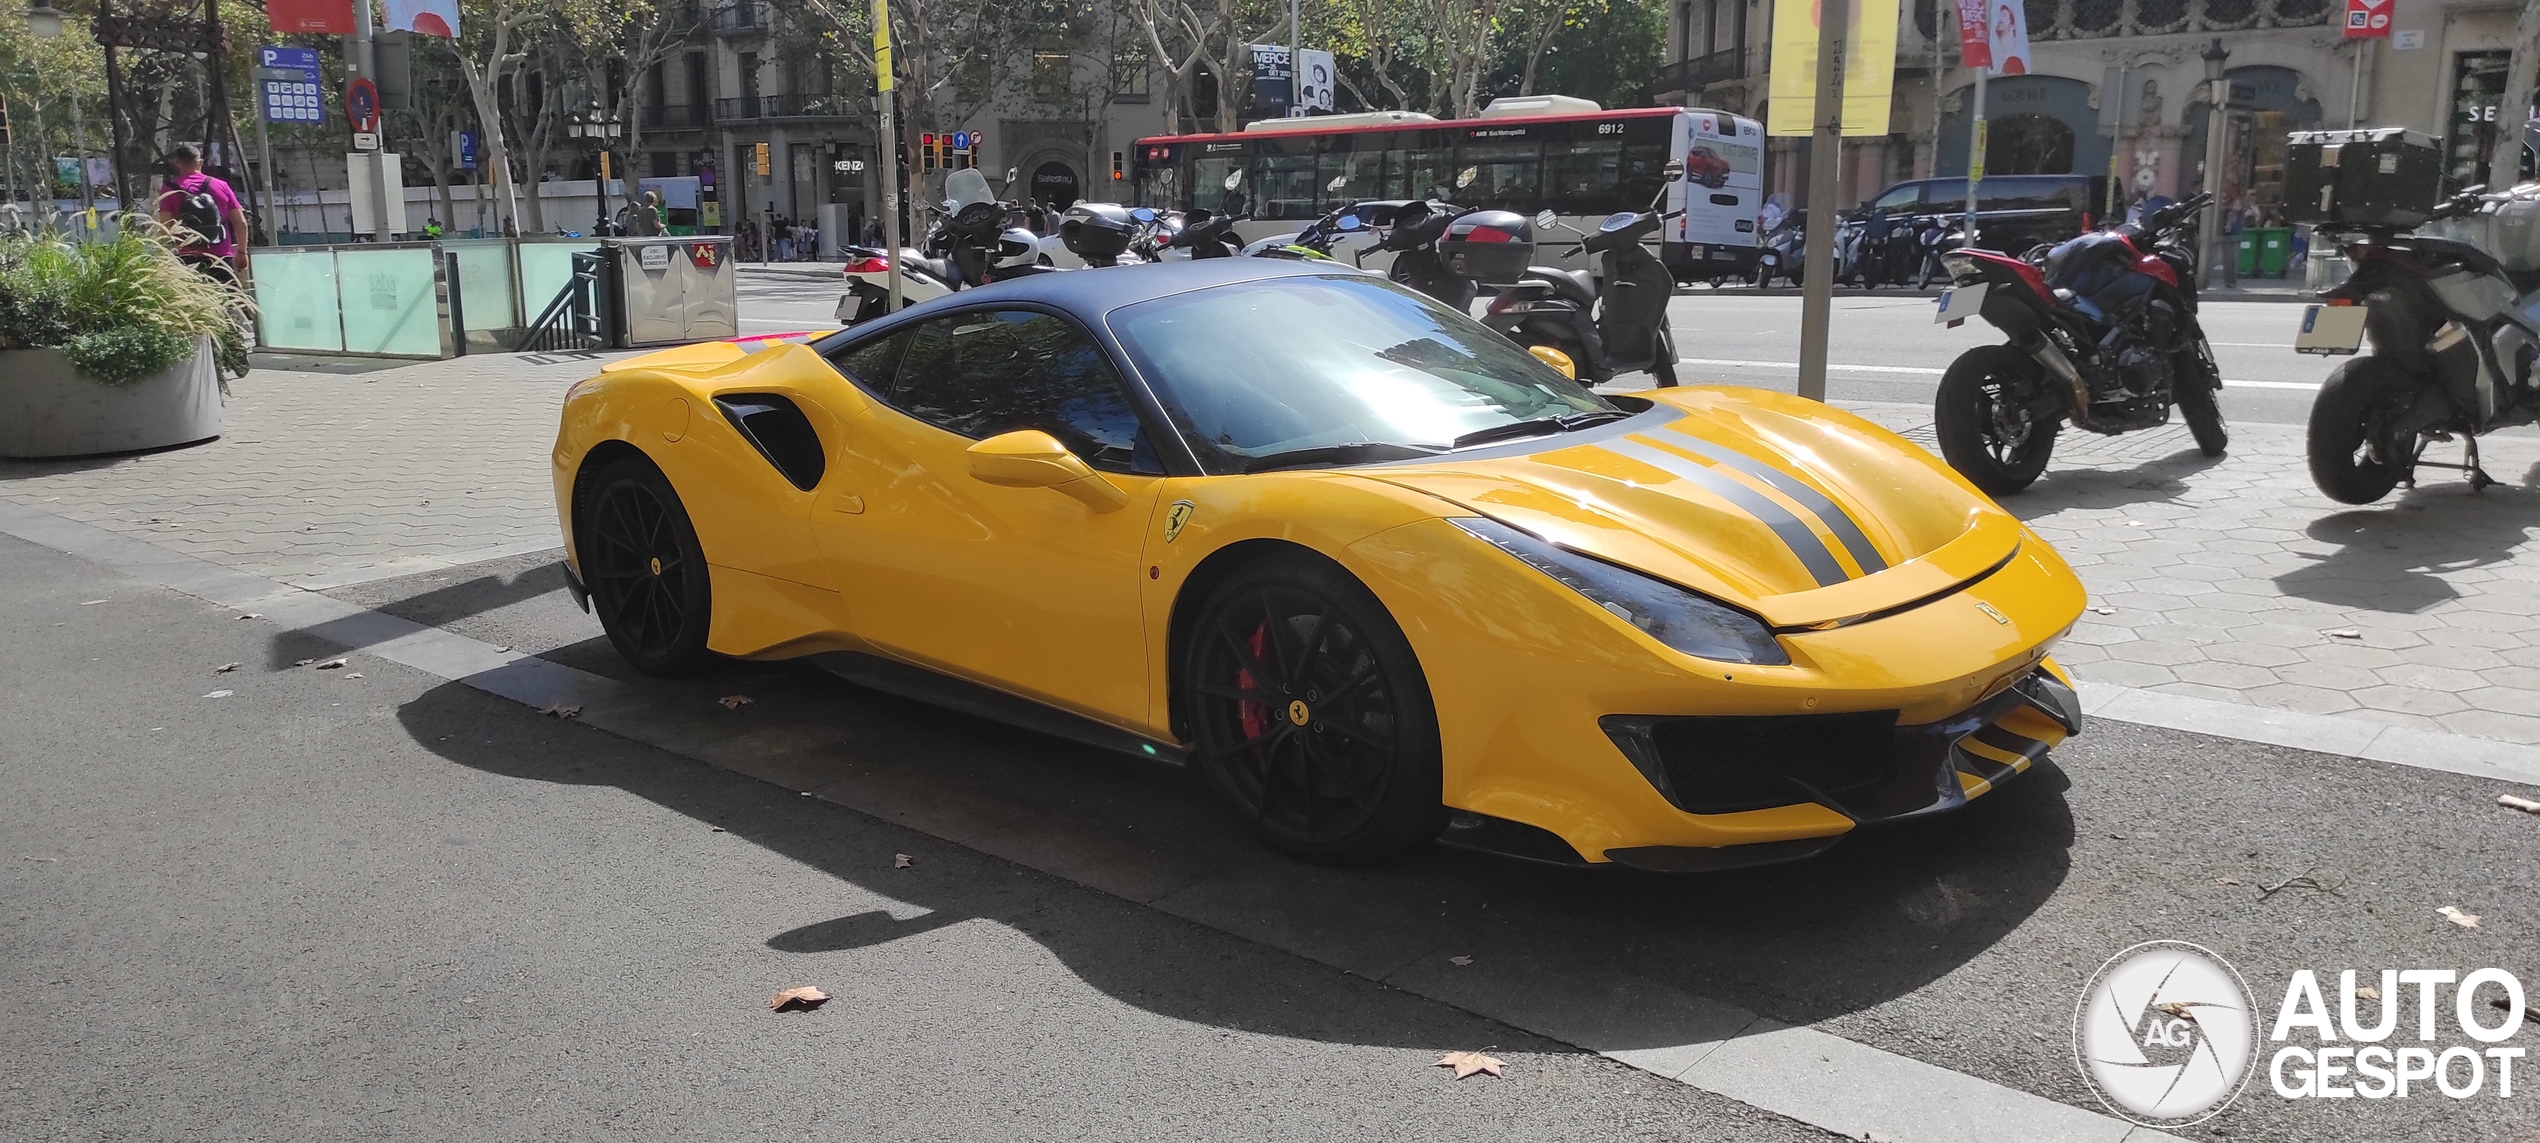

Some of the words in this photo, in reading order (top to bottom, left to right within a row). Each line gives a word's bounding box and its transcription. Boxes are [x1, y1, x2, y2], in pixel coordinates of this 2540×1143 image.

[264, 50, 277, 66] P
[1598, 123, 1625, 134] 6912
[461, 134, 469, 154] P
[1037, 174, 1073, 184] Safestay
[369, 268, 398, 291] saba
